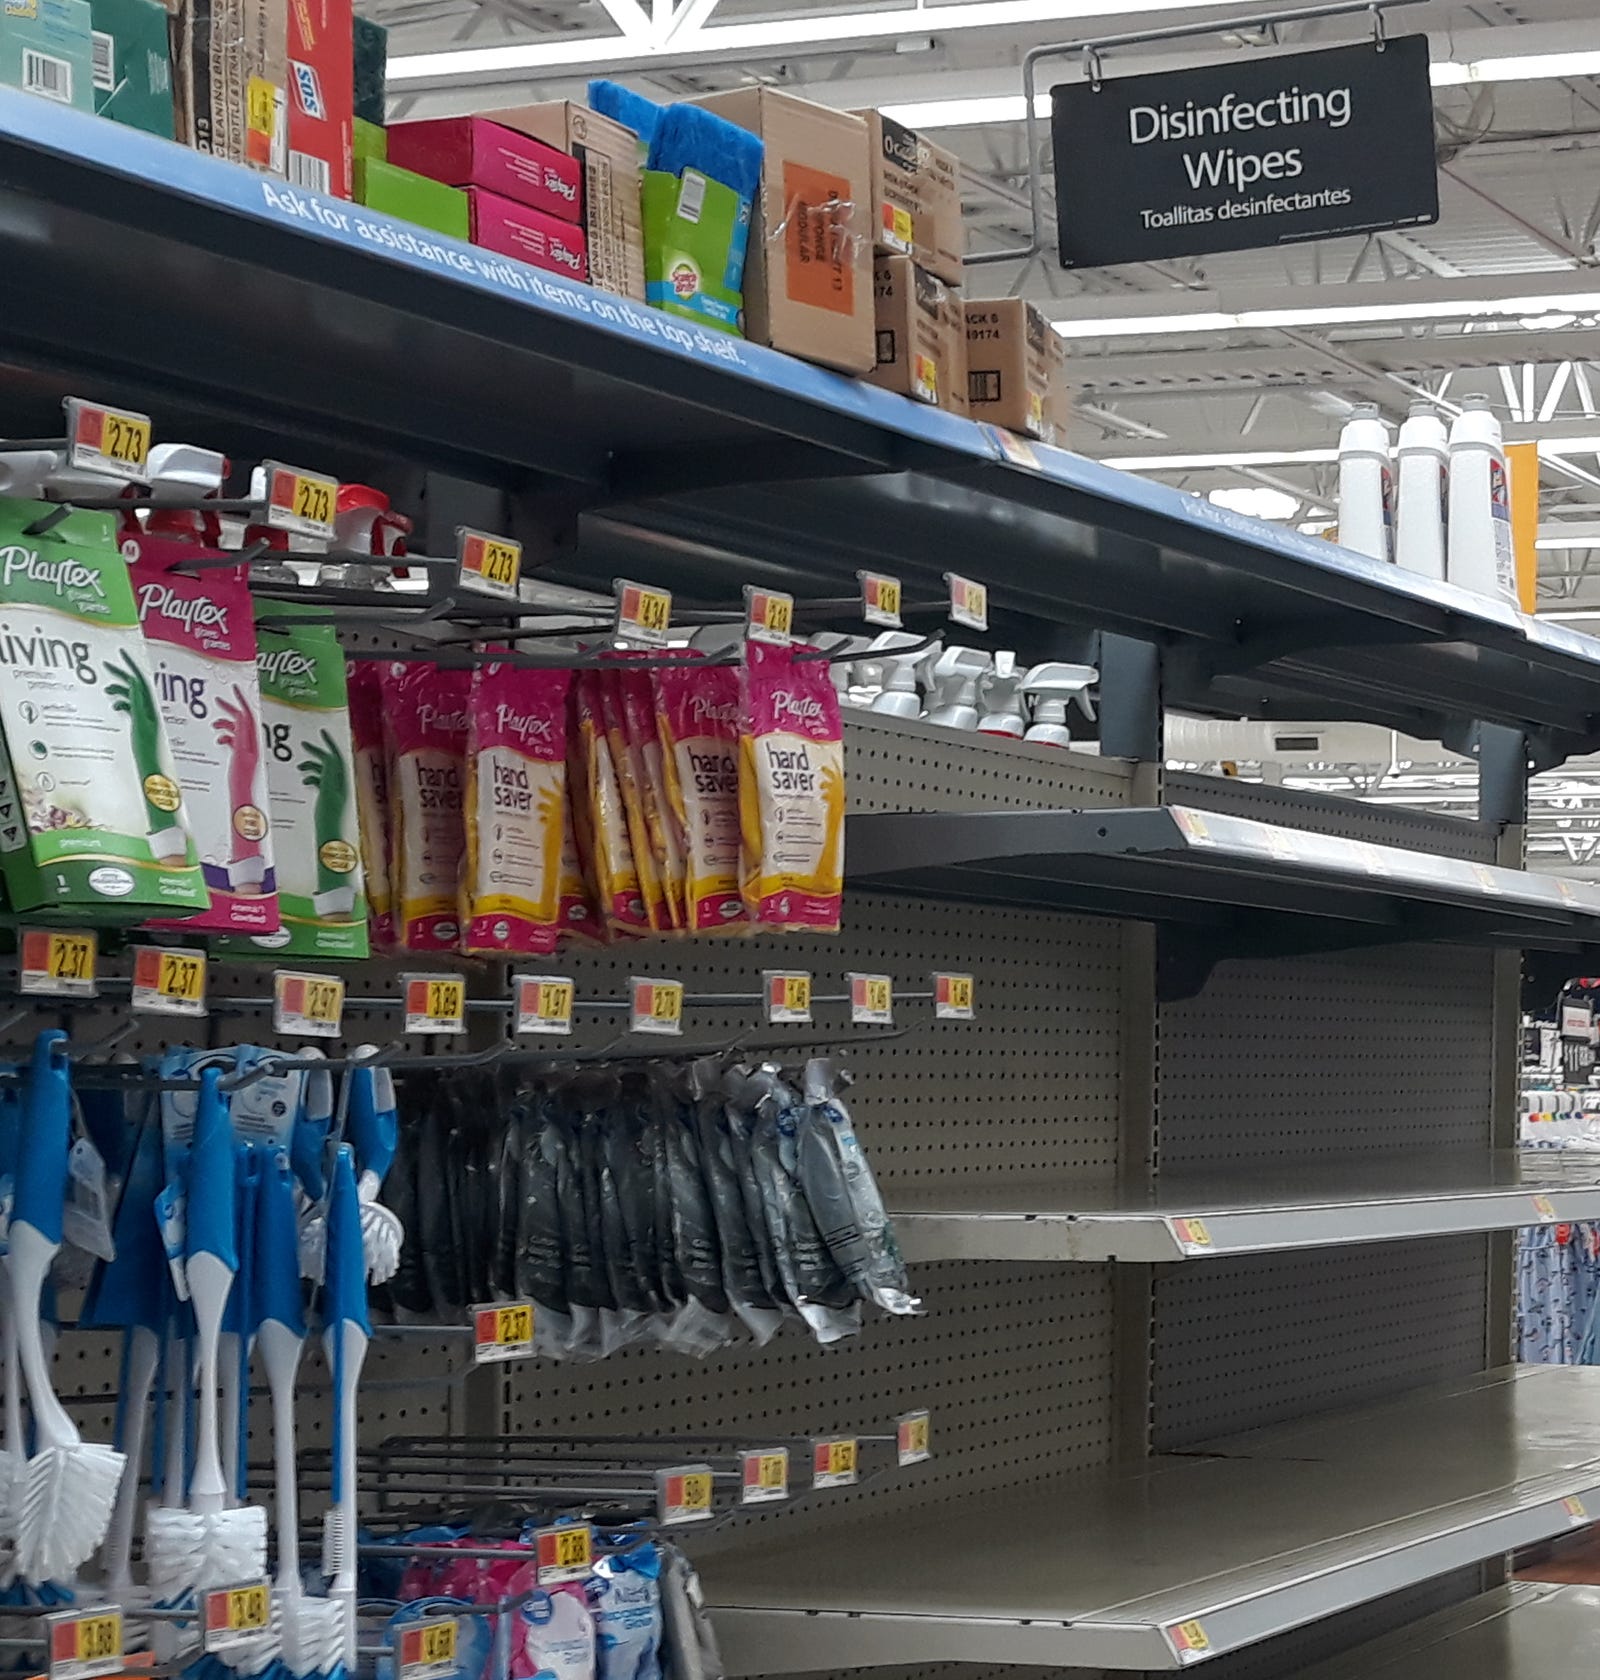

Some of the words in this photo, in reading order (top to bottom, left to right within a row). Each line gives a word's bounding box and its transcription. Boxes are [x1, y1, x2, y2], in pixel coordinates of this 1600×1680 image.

[297, 66, 318, 114] SOS
[212, 77, 225, 159] CLEANING
[230, 99, 241, 147] BOTTLE
[1129, 86, 1352, 145] Disinfecting
[1183, 147, 1303, 193] Wipes
[1140, 205, 1214, 229] Toallitas
[1216, 187, 1352, 221] desinfectantes
[261, 182, 314, 221] Ask
[311, 199, 350, 232] for
[354, 218, 478, 275] assistance
[476, 259, 530, 294] with
[525, 272, 592, 313] items
[592, 299, 622, 323] on
[621, 305, 659, 337] the
[657, 315, 695, 352] top
[693, 328, 747, 366] shelf.
[110, 422, 143, 463] 2.73
[300, 482, 329, 522] 2.73
[0, 546, 107, 598] Playtex
[487, 548, 514, 584] 2.73
[137, 583, 229, 634] Playtex
[256, 649, 319, 684] aytex
[415, 758, 458, 787] hand
[492, 755, 529, 788] hand
[687, 744, 738, 775] hand
[765, 741, 811, 772] hand
[493, 786, 533, 813] saver
[771, 769, 815, 791] saver
